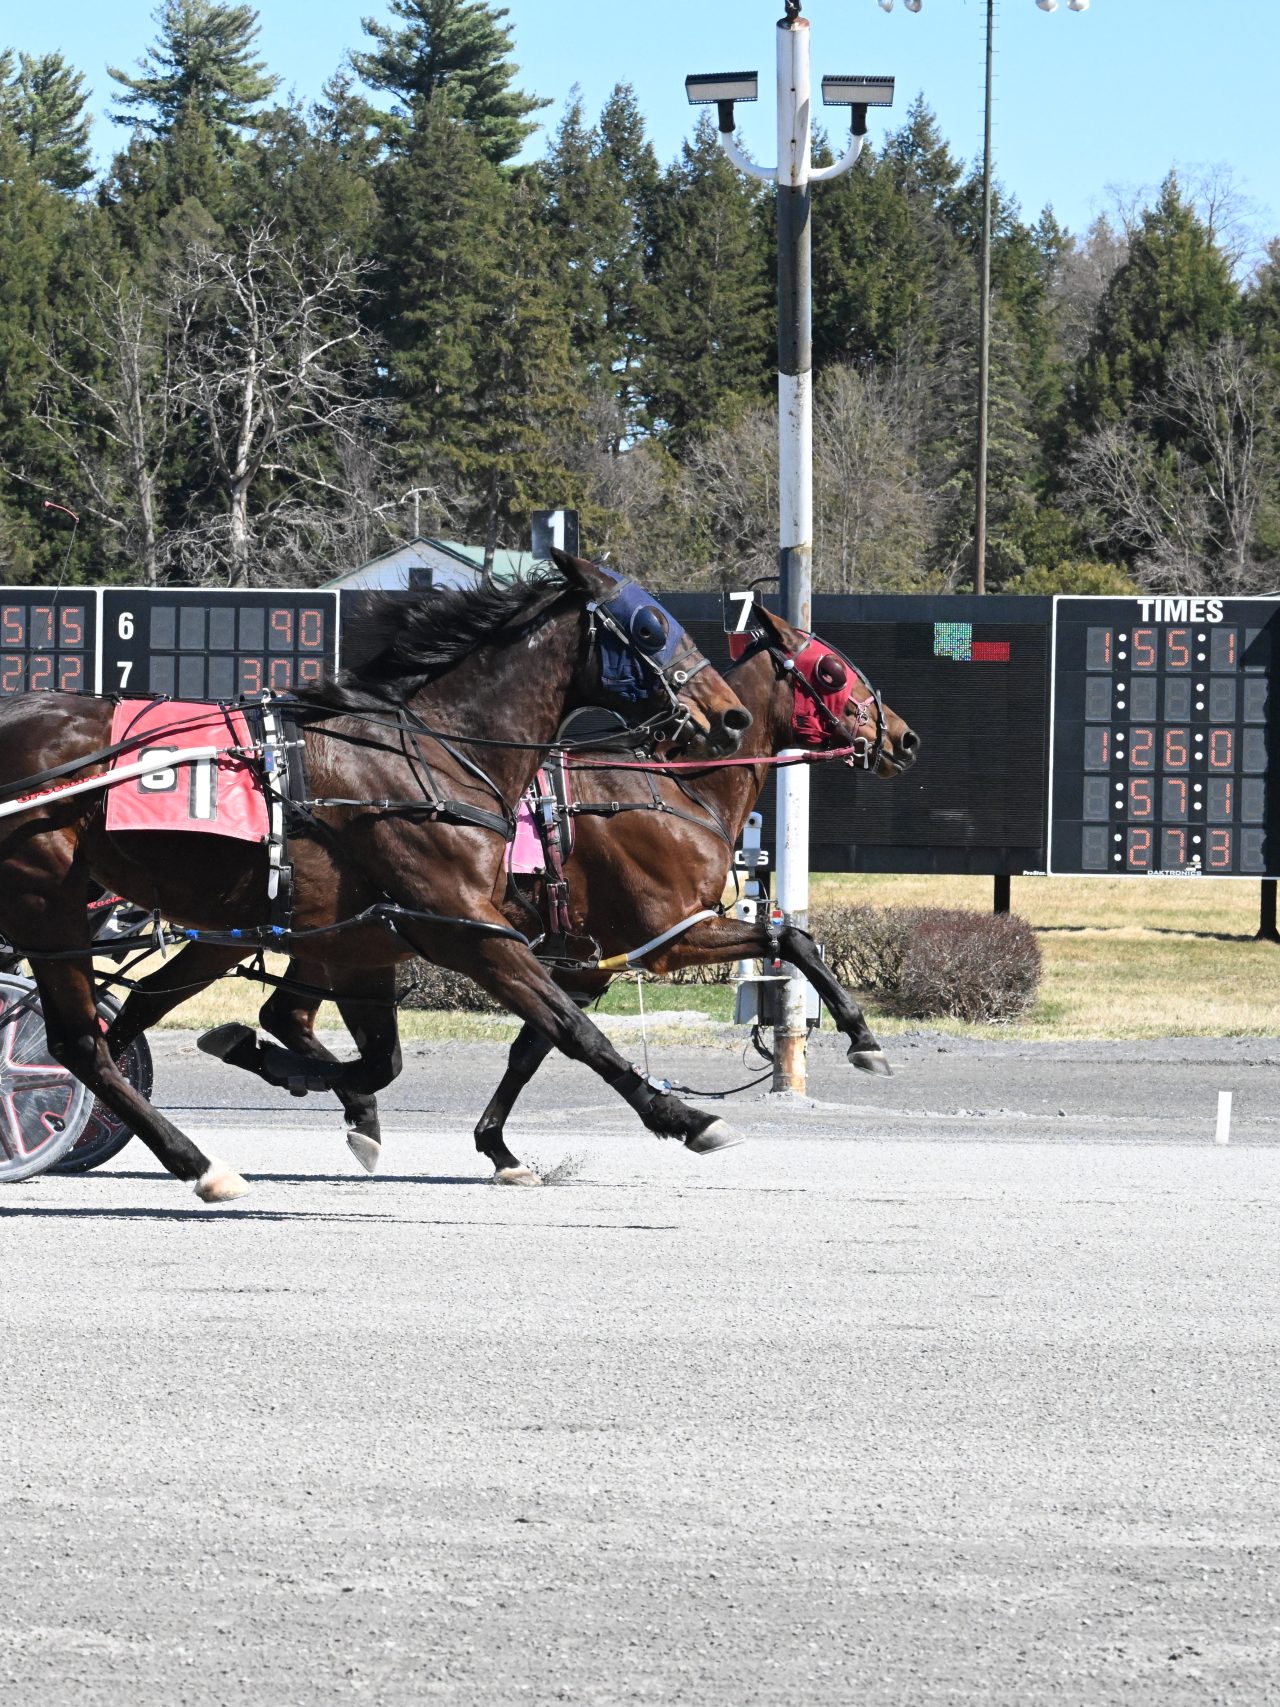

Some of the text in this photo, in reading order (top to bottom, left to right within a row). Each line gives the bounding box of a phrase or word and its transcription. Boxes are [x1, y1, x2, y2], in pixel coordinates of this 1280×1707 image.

[2, 607, 82, 644] 575
[118, 611, 134, 640] 6
[271, 610, 322, 647] 90
[729, 590, 755, 632] 7
[1136, 599, 1224, 623] TIMES
[2, 656, 81, 692] 222
[116, 661, 133, 688] 7
